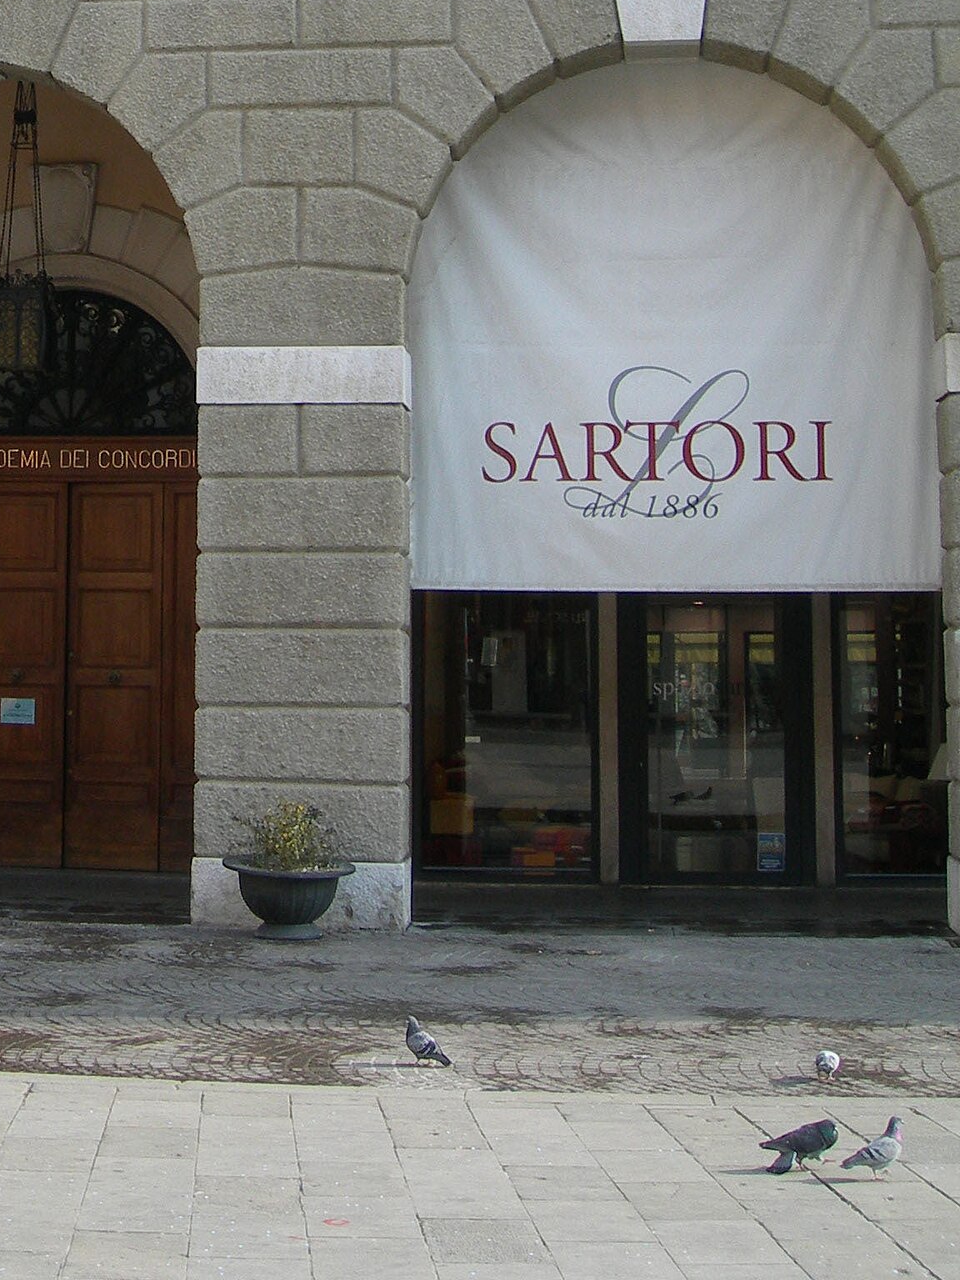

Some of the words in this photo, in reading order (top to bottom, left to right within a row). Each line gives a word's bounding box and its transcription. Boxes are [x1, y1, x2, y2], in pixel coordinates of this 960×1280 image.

[59, 449, 89, 468] DEI
[97, 449, 197, 469] CONCORDI
[480, 420, 835, 483] SARTORI
[582, 491, 629, 519] dal
[644, 492, 722, 519] 1886
